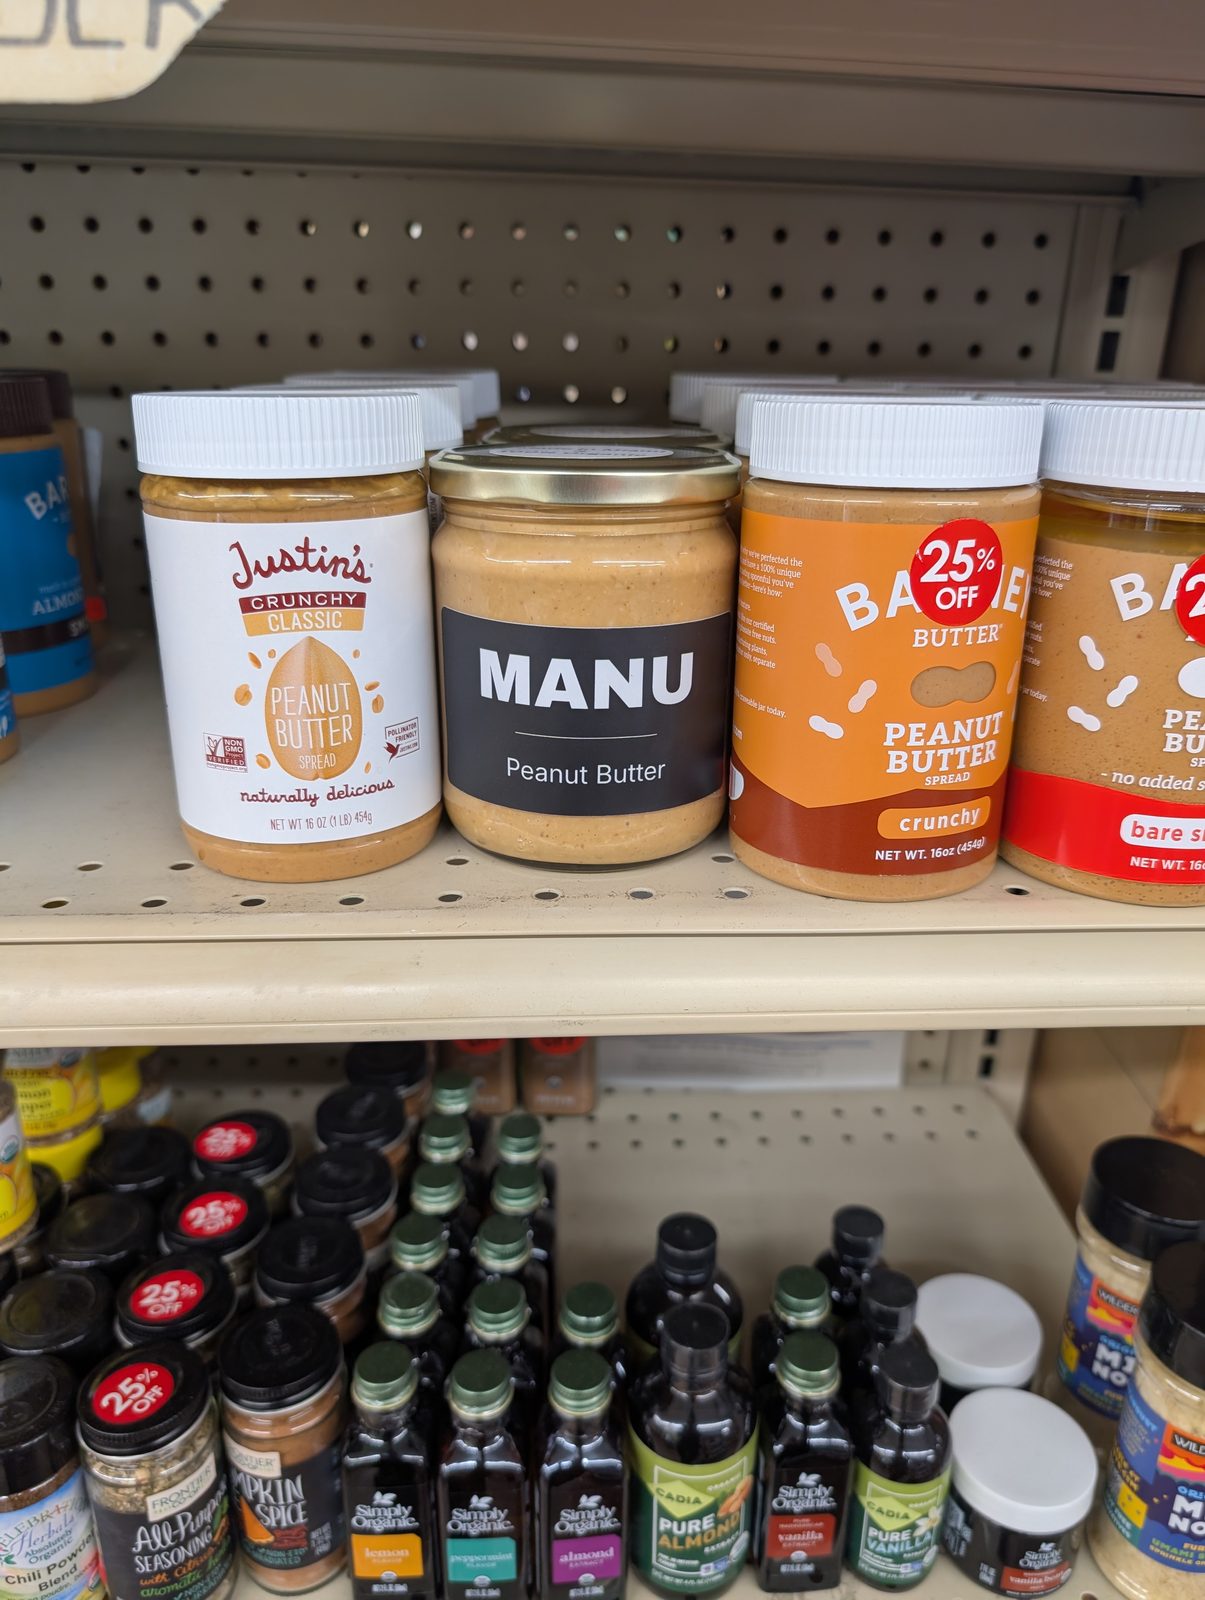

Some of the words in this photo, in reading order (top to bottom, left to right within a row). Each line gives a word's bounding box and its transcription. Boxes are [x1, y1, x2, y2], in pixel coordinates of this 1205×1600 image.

[229, 536, 372, 590] Justin's
[760, 553, 789, 566] perfected
[790, 557, 803, 567] the
[920, 539, 995, 583] 25%
[1061, 559, 1073, 570] the
[760, 562, 776, 574] 100%
[776, 567, 801, 579] unique
[1048, 569, 1071, 580] unique
[772, 578, 795, 589] you've
[251, 593, 357, 610] CRUNCHY
[935, 585, 980, 610] OFF
[267, 611, 342, 632] CLASSIC
[753, 620, 775, 633] certified
[762, 634, 777, 645] nuts.
[912, 624, 999, 648] BUTTER
[752, 657, 776, 669] separate
[480, 647, 694, 710] MANU
[271, 683, 351, 715] PEANUT
[1029, 689, 1048, 702] today.
[758, 702, 766, 712] jar
[766, 705, 787, 718] today.
[275, 714, 353, 749] BUTTER
[388, 722, 417, 737] POLLINATOR
[395, 730, 417, 742] FRIENDLY
[883, 711, 1004, 747] PEANUT
[225, 745, 244, 753] GMO
[886, 739, 997, 773] BUTTER
[208, 756, 245, 766] VERIFIED
[299, 753, 336, 769] SPREAD
[507, 756, 588, 785] Peanut
[596, 763, 666, 785] Butter
[925, 772, 971, 786] SPREAD
[1111, 771, 1135, 785] no
[1139, 774, 1193, 791] added
[241, 788, 319, 807] naturally
[326, 779, 395, 801] delicious
[270, 819, 285, 830] NET
[288, 818, 302, 830] WT
[305, 818, 314, 830] 16
[317, 817, 327, 829] OZ
[339, 813, 353, 827] LB)
[354, 810, 373, 825] 454g
[899, 807, 981, 832] crunchy
[1130, 820, 1184, 842] bare
[875, 850, 901, 861] NET
[904, 849, 927, 860] WT.
[930, 846, 955, 858] 16oz
[957, 836, 985, 855] (454g)
[1130, 856, 1159, 870] NET
[1161, 859, 1187, 871] WT.
[139, 1280, 198, 1307] 25%
[147, 1301, 183, 1317] OFF
[101, 1367, 159, 1416] 25%
[132, 1384, 164, 1413] OFF
[656, 1487, 703, 1505] CADIA
[779, 1484, 834, 1499] Simply
[355, 1503, 413, 1519] Simply
[560, 1504, 617, 1520] Simply
[772, 1496, 837, 1513] Organic
[866, 1501, 910, 1519] CADIA
[255, 1500, 308, 1528] SPICE
[451, 1507, 509, 1523] Simply
[351, 1515, 418, 1532] Organic
[447, 1519, 514, 1536] Organic
[553, 1517, 620, 1535] Organic
[657, 1511, 740, 1551] ALMOND
[659, 1513, 716, 1535] PURE
[868, 1526, 913, 1541] PURE
[28, 1536, 73, 1565] Organic
[134, 1525, 213, 1573] SEASONING
[867, 1532, 932, 1553] VANILLA
[364, 1548, 410, 1558] lemon
[450, 1551, 513, 1564] peppermint
[560, 1546, 615, 1562] almond
[1024, 1549, 1063, 1560] Simply
[5, 1569, 42, 1585] Chili
[38, 1563, 78, 1592] Blend
